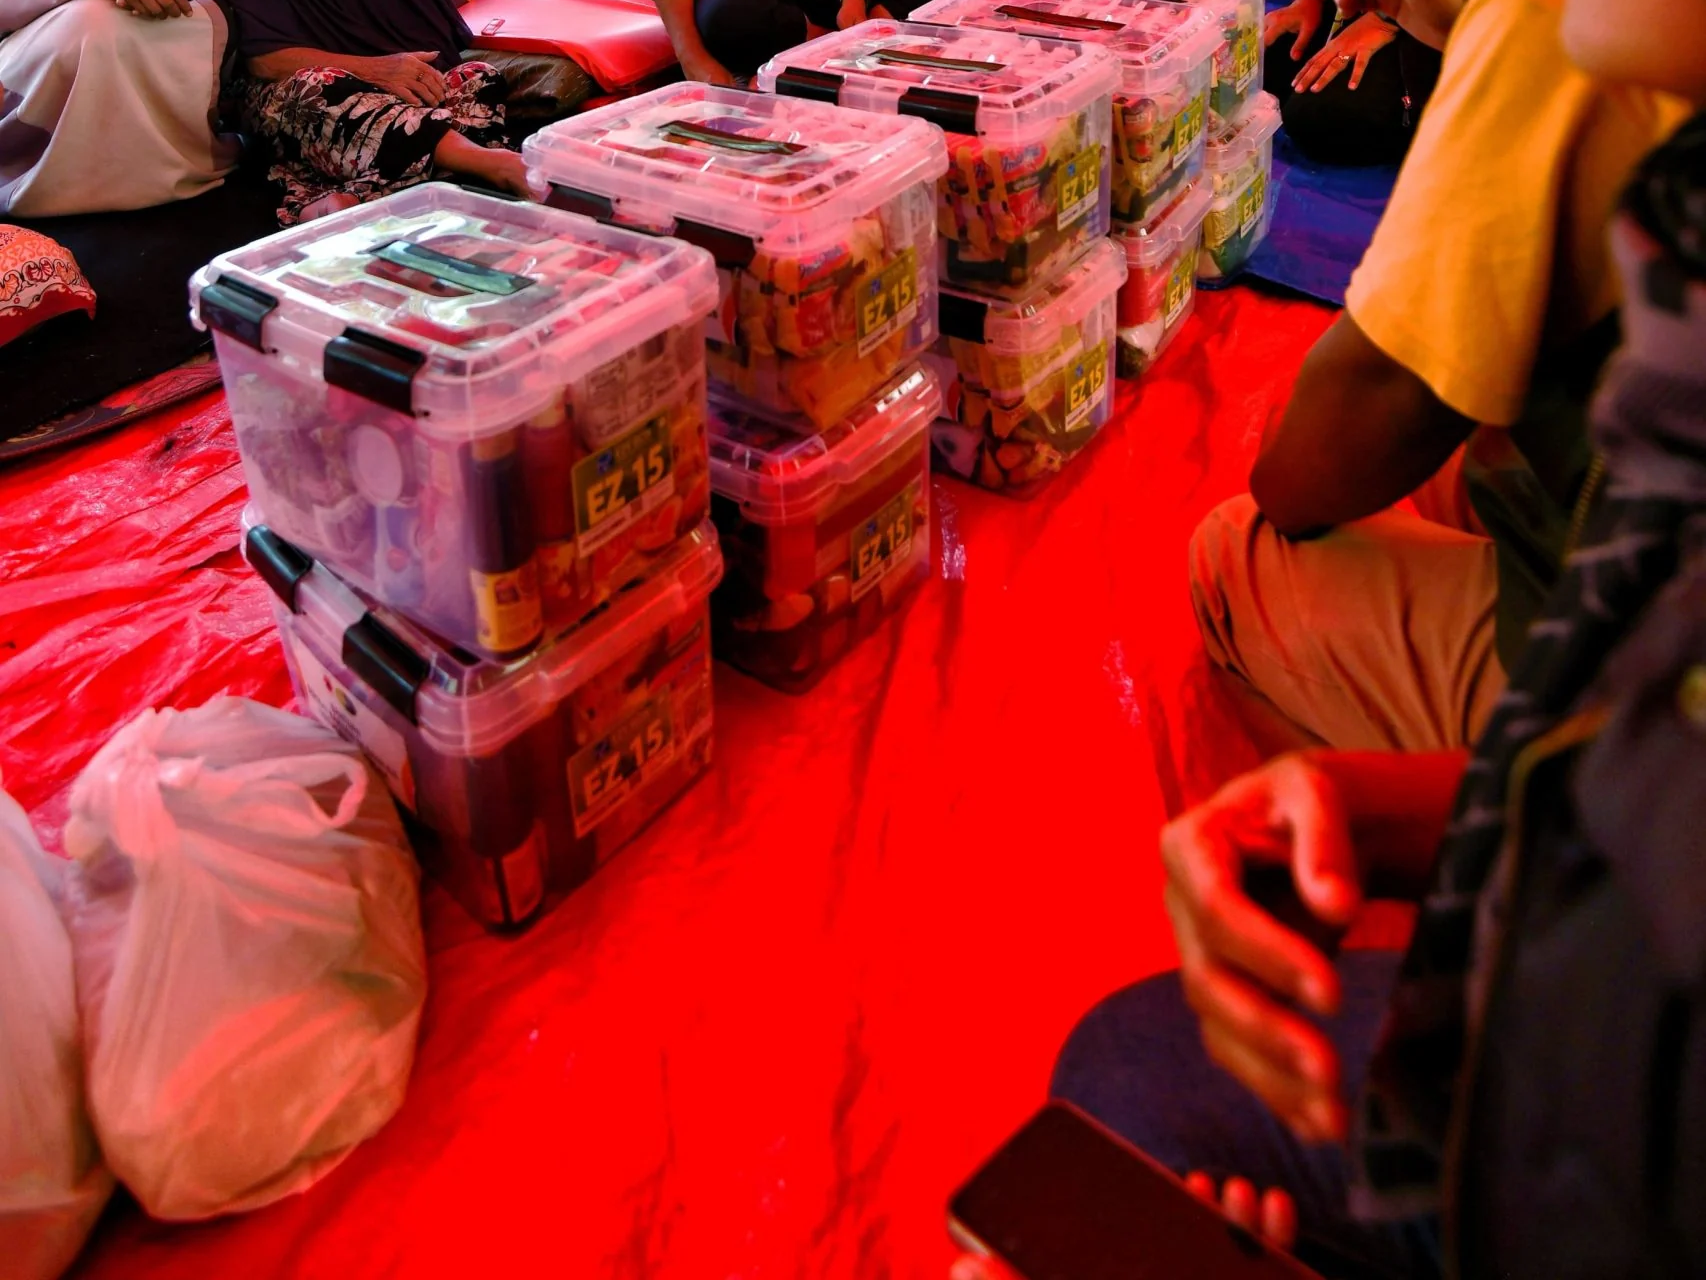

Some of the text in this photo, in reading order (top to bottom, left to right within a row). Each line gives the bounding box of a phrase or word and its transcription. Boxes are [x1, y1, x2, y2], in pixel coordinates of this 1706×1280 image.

[1062, 178, 1079, 210] EZ
[1083, 167, 1096, 195] 15
[864, 276, 911, 335] EZ 15
[1071, 363, 1102, 411] EZ 15
[587, 470, 626, 527] EZ
[632, 443, 664, 493] 15
[859, 514, 906, 577] EZ 15
[583, 718, 664, 808] EZ 15
